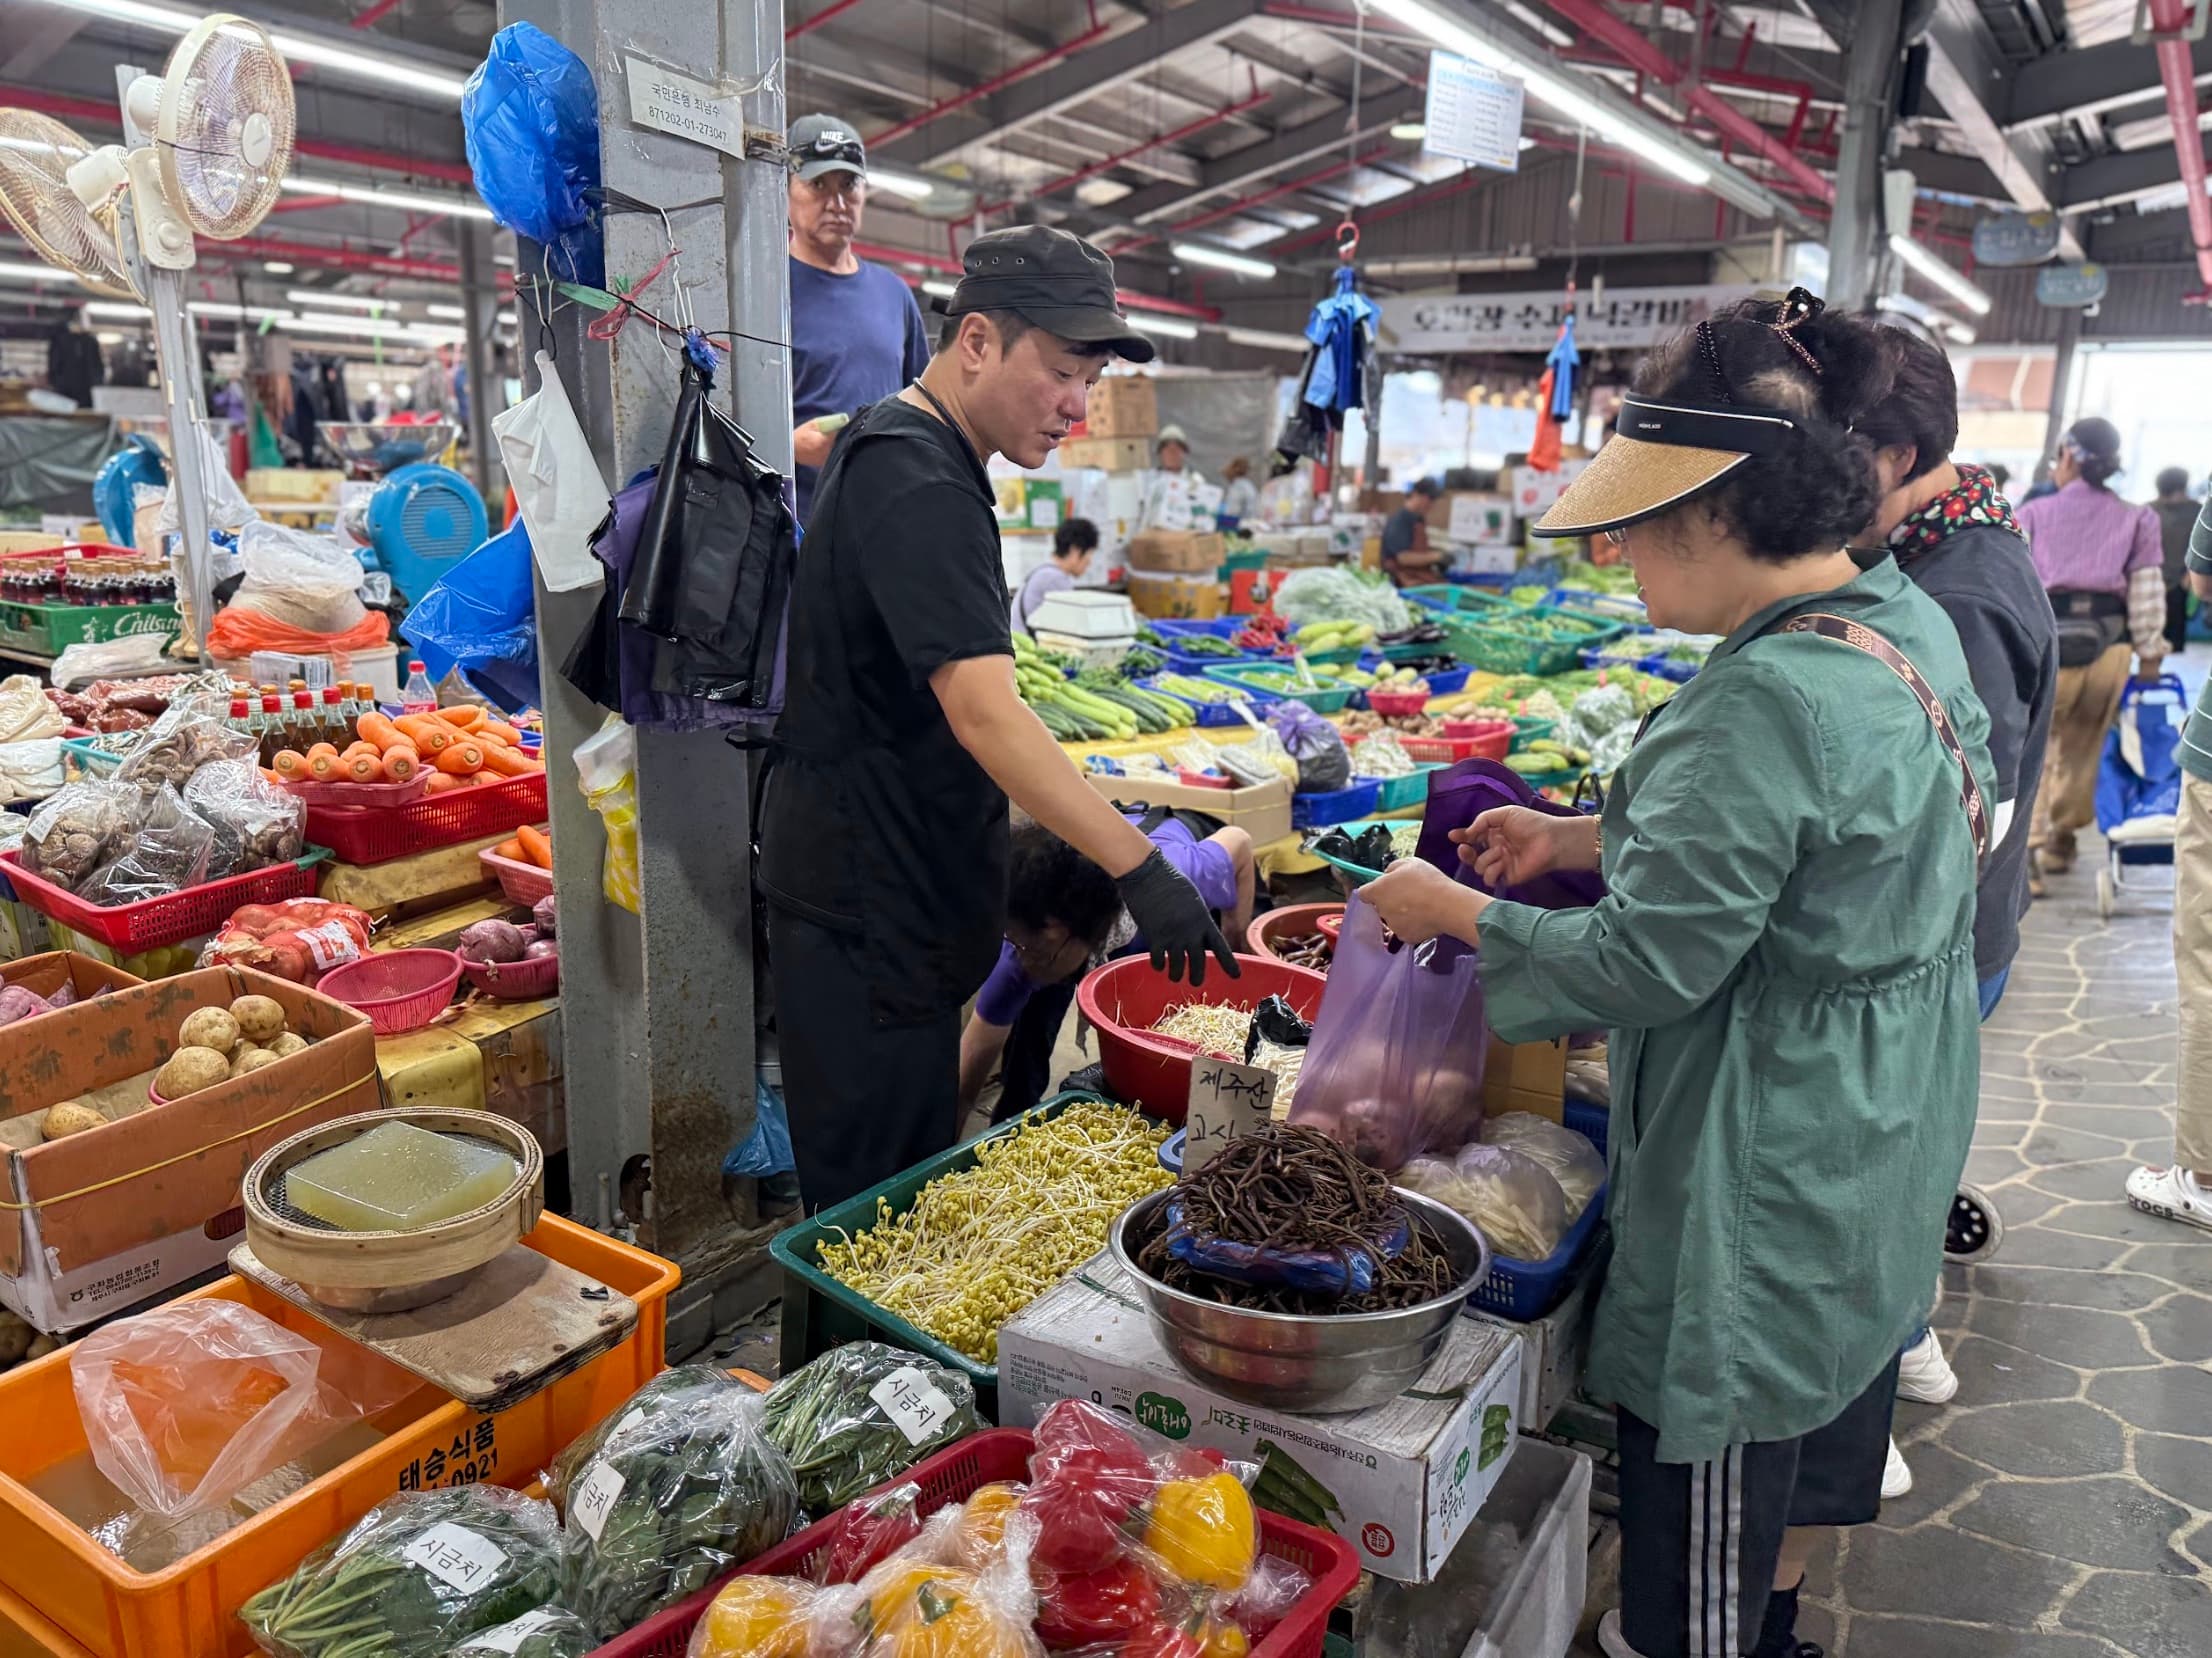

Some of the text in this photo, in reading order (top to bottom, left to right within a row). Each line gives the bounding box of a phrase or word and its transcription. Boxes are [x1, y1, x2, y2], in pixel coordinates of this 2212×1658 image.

[651, 83, 721, 118] 국민은행 최남수
[649, 106, 727, 142] 871202-01-273047
[821, 130, 844, 141] NIKE
[1200, 1068, 1272, 1110] 제주산
[2127, 1194, 2174, 1217] crocs
[887, 1379, 937, 1428] 시금치
[399, 1416, 495, 1491] 태승식품
[420, 1539, 483, 1583] 시금치
